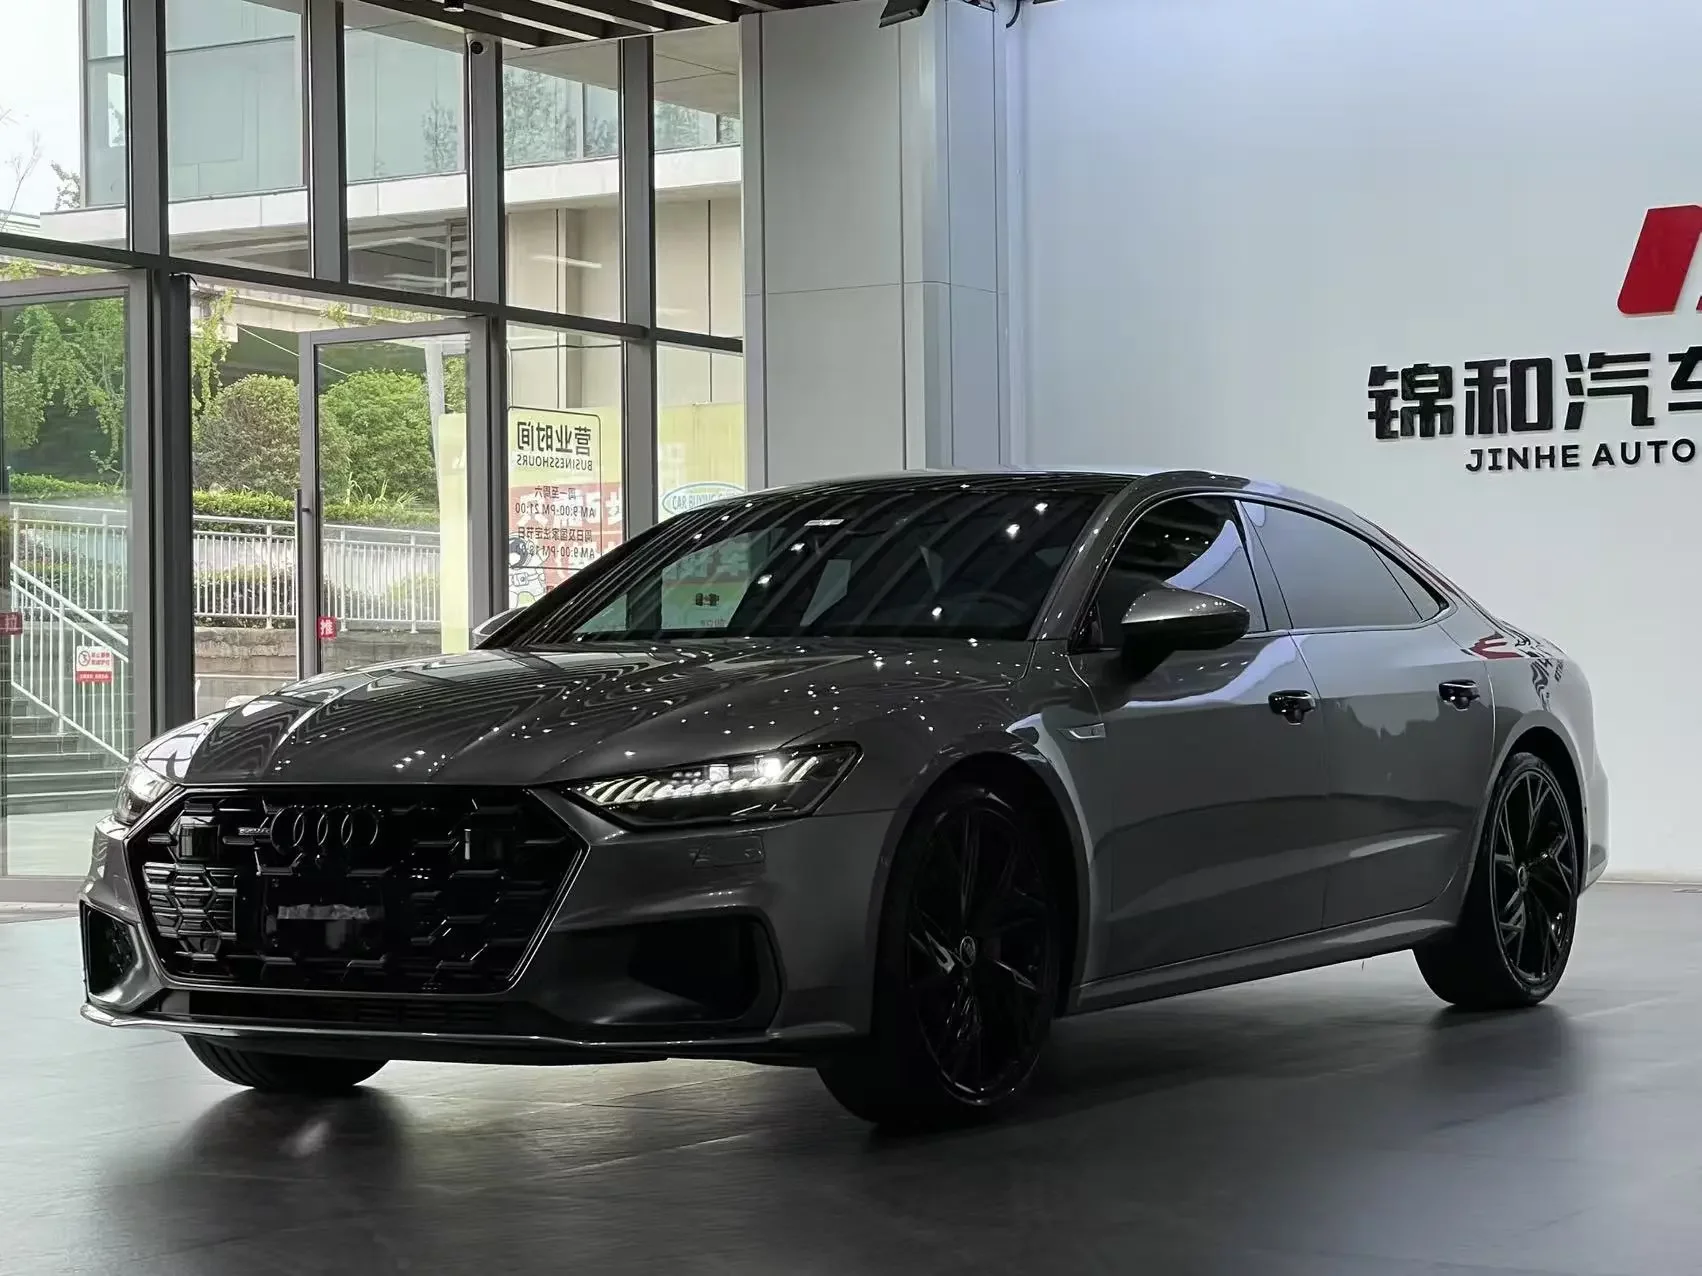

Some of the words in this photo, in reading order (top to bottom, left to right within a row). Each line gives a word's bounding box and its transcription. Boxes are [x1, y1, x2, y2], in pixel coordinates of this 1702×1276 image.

[1465, 444, 1580, 472] JINHE
[1592, 439, 1696, 467] AUTO
[4, 615, 18, 632] 拉
[320, 619, 334, 636] 推
